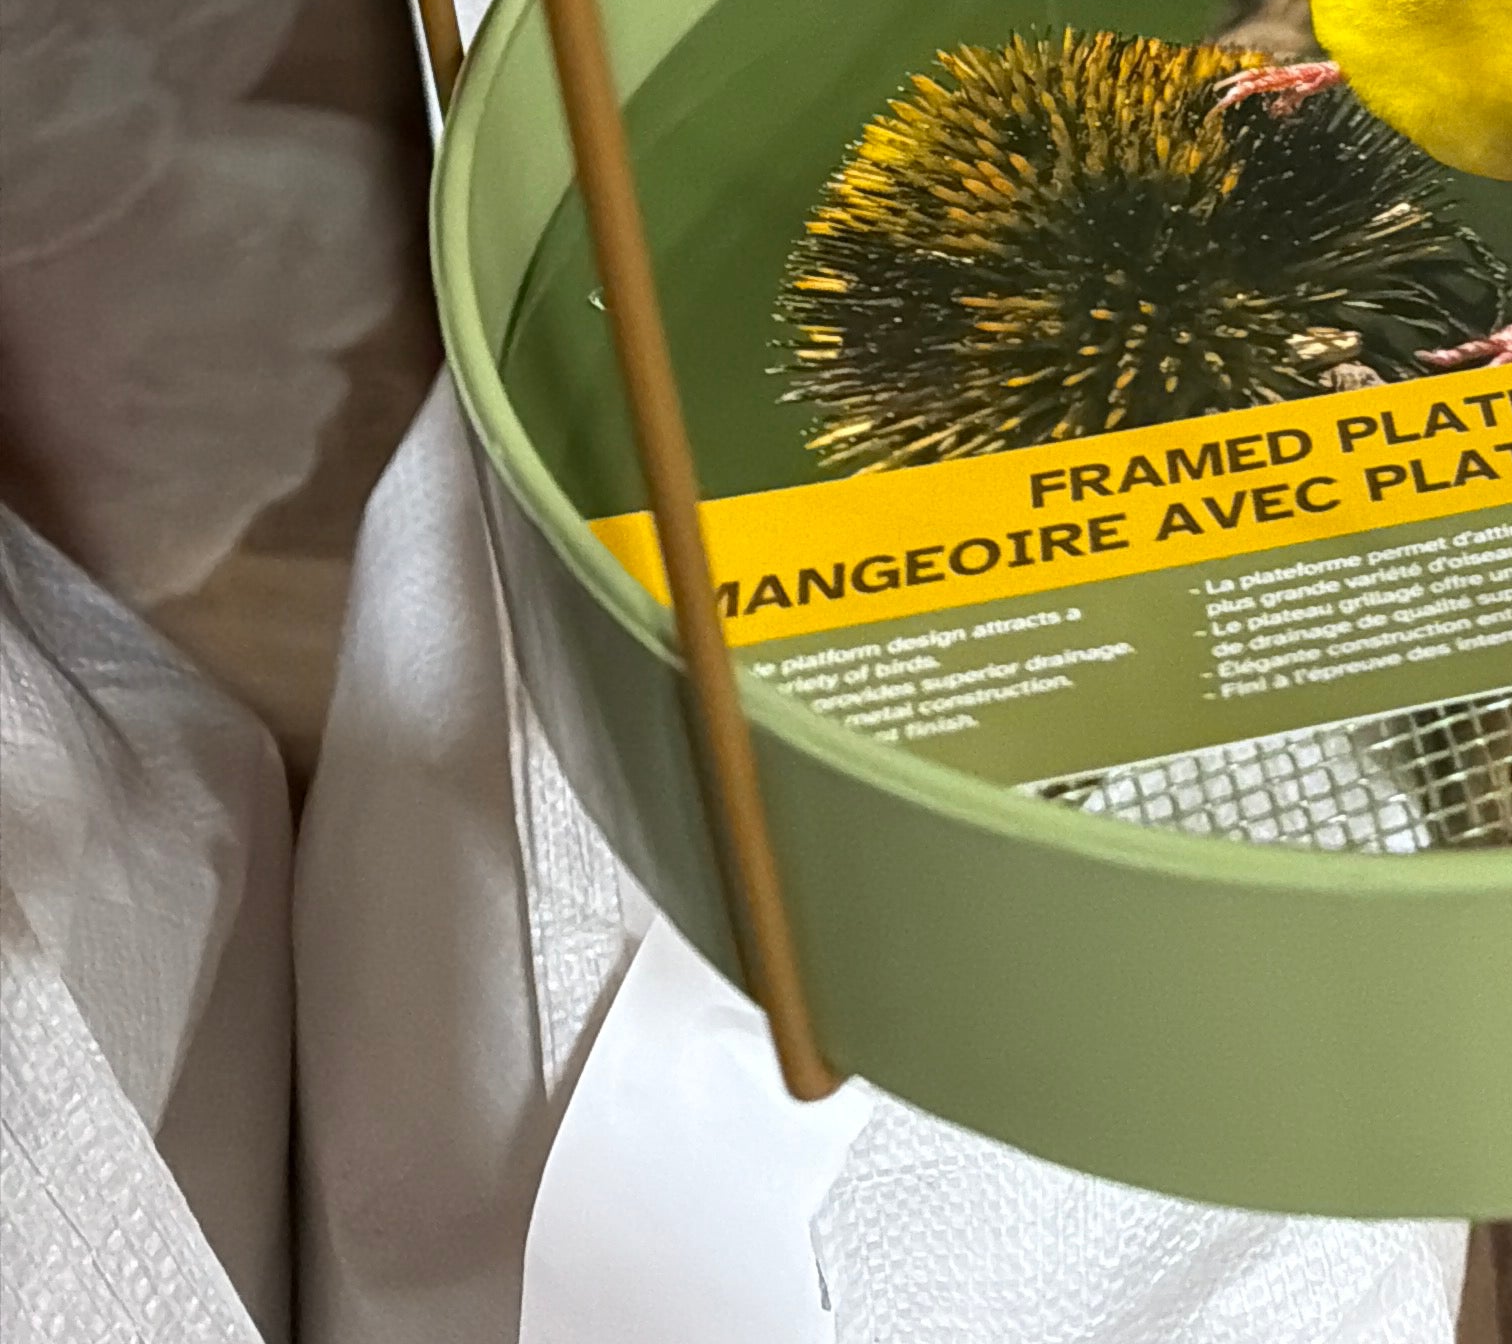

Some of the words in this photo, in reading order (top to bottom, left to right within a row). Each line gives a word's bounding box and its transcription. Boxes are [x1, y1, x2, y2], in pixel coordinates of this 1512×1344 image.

[1029, 428, 1314, 509] FRAMED
[1154, 475, 1341, 542] AVEC
[1205, 578, 1235, 595] La
[1240, 555, 1362, 590] plateforme
[1367, 537, 1448, 565] permet
[1206, 597, 1256, 618] plus
[1260, 580, 1341, 608] grande
[1344, 562, 1422, 589] variété
[1211, 621, 1242, 637] Le
[1247, 603, 1334, 634] plateau
[1339, 583, 1424, 614] grillagé
[1429, 574, 1484, 593] offre
[1211, 642, 1244, 658] de
[1248, 620, 1352, 652] drainage
[1356, 614, 1388, 630] de
[1392, 595, 1472, 623] qualité
[781, 644, 882, 677] platform
[887, 627, 967, 655] design
[972, 611, 1061, 639] attracts
[1066, 608, 1082, 622] a
[1326, 618, 1472, 656] construction
[843, 664, 869, 685] of
[920, 662, 1019, 693] superior
[1221, 676, 1267, 699] Fini
[1406, 644, 1451, 662] des
